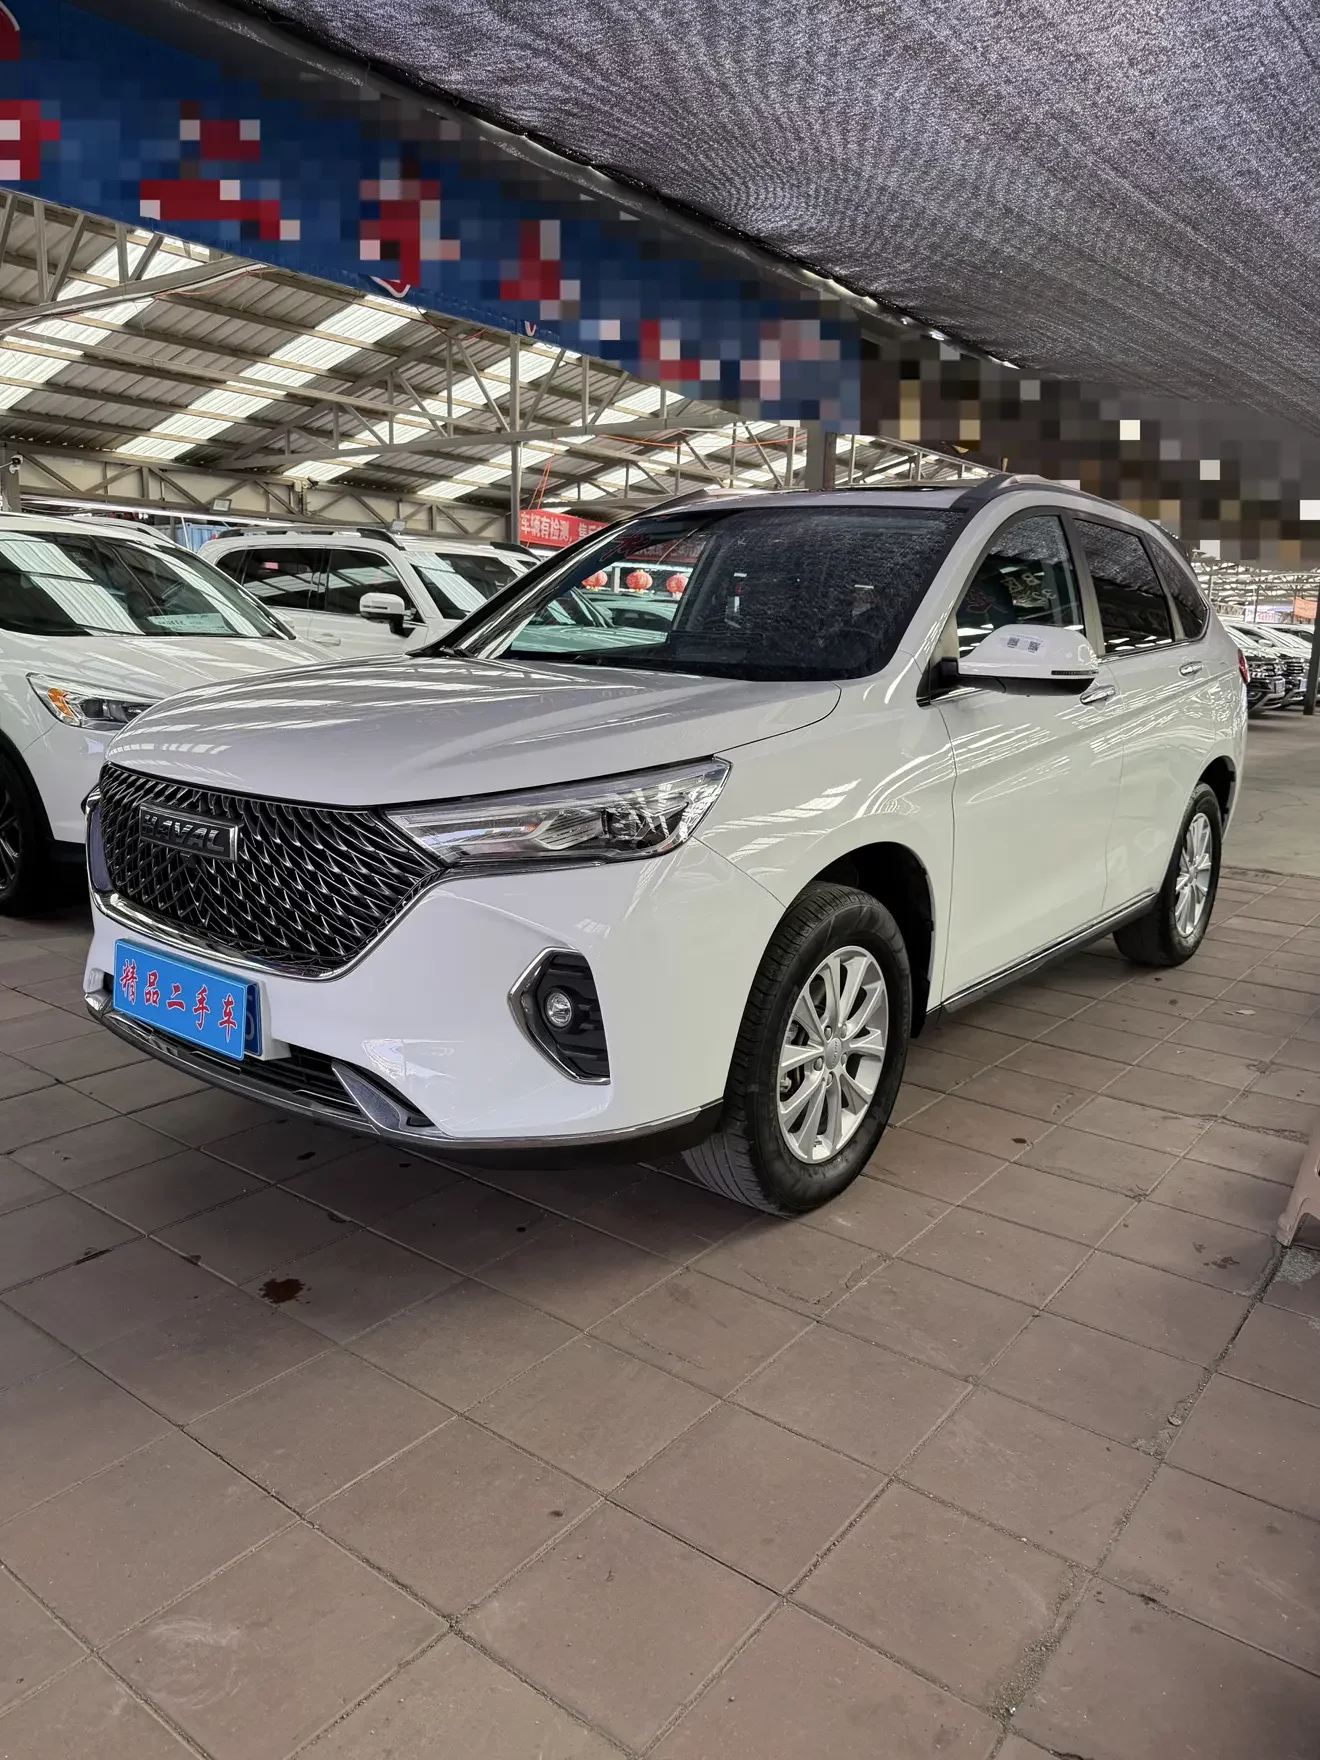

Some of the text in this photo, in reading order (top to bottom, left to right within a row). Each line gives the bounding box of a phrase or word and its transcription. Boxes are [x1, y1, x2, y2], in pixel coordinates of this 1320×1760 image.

[119, 959, 237, 1043] 精品二手车
